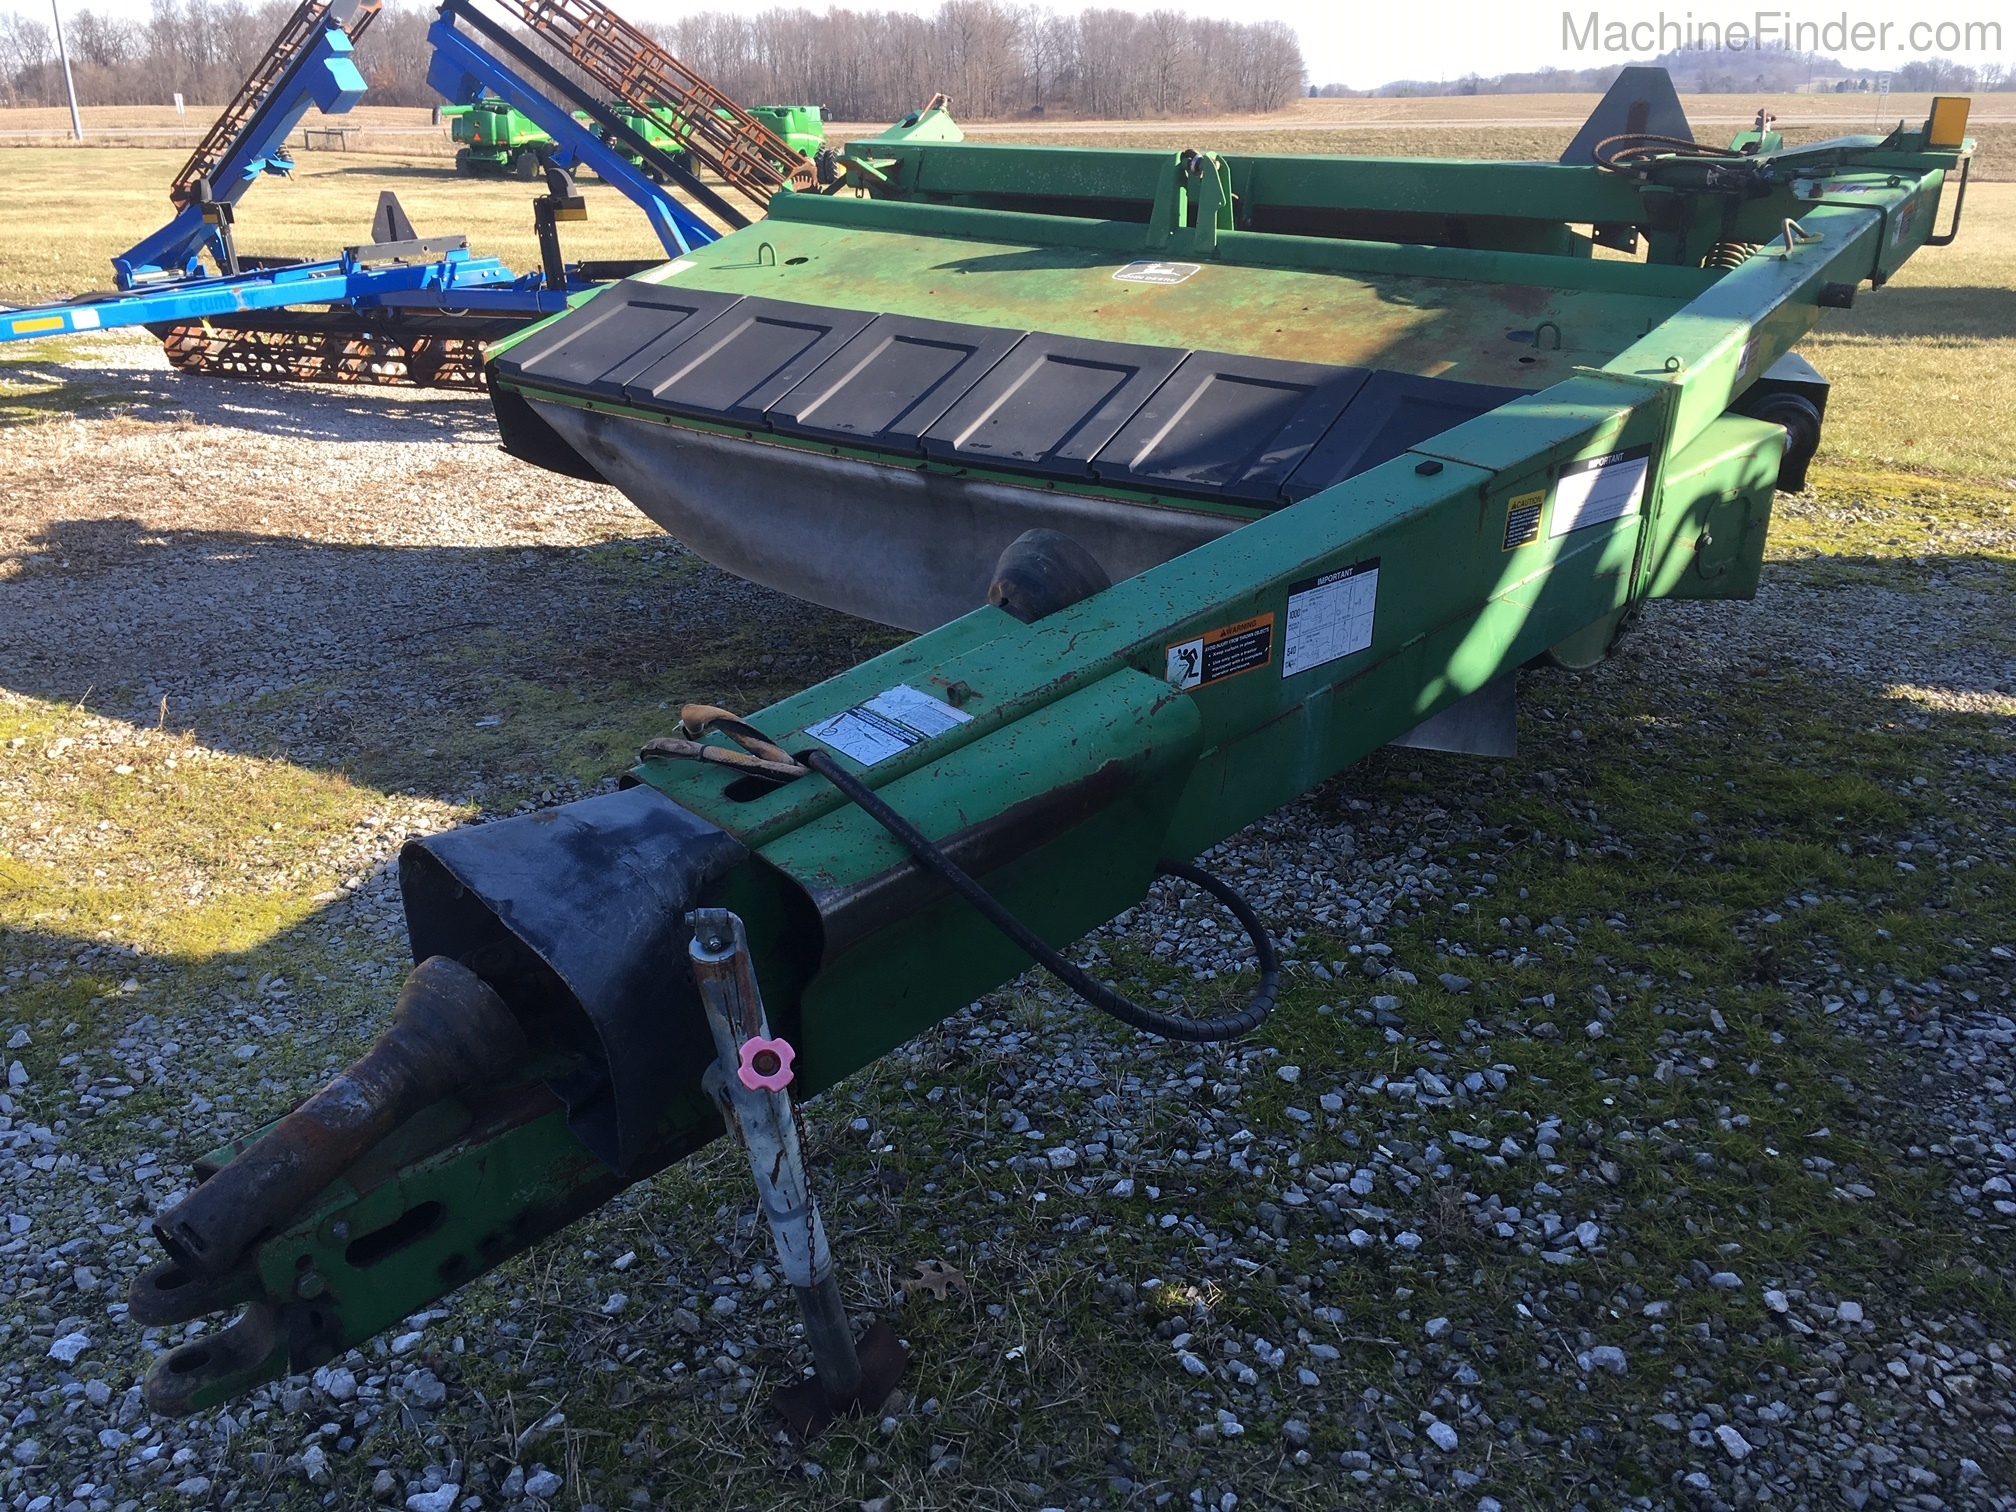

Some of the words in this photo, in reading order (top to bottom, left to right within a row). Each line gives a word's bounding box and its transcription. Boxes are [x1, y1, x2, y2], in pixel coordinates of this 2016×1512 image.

[1588, 452, 1624, 469] IMPORTANT
[1516, 496, 1542, 508] CAUTION
[1317, 568, 1354, 586] IMPORTANT
[1225, 620, 1257, 634] WARNING
[1286, 646, 1297, 657] 540
